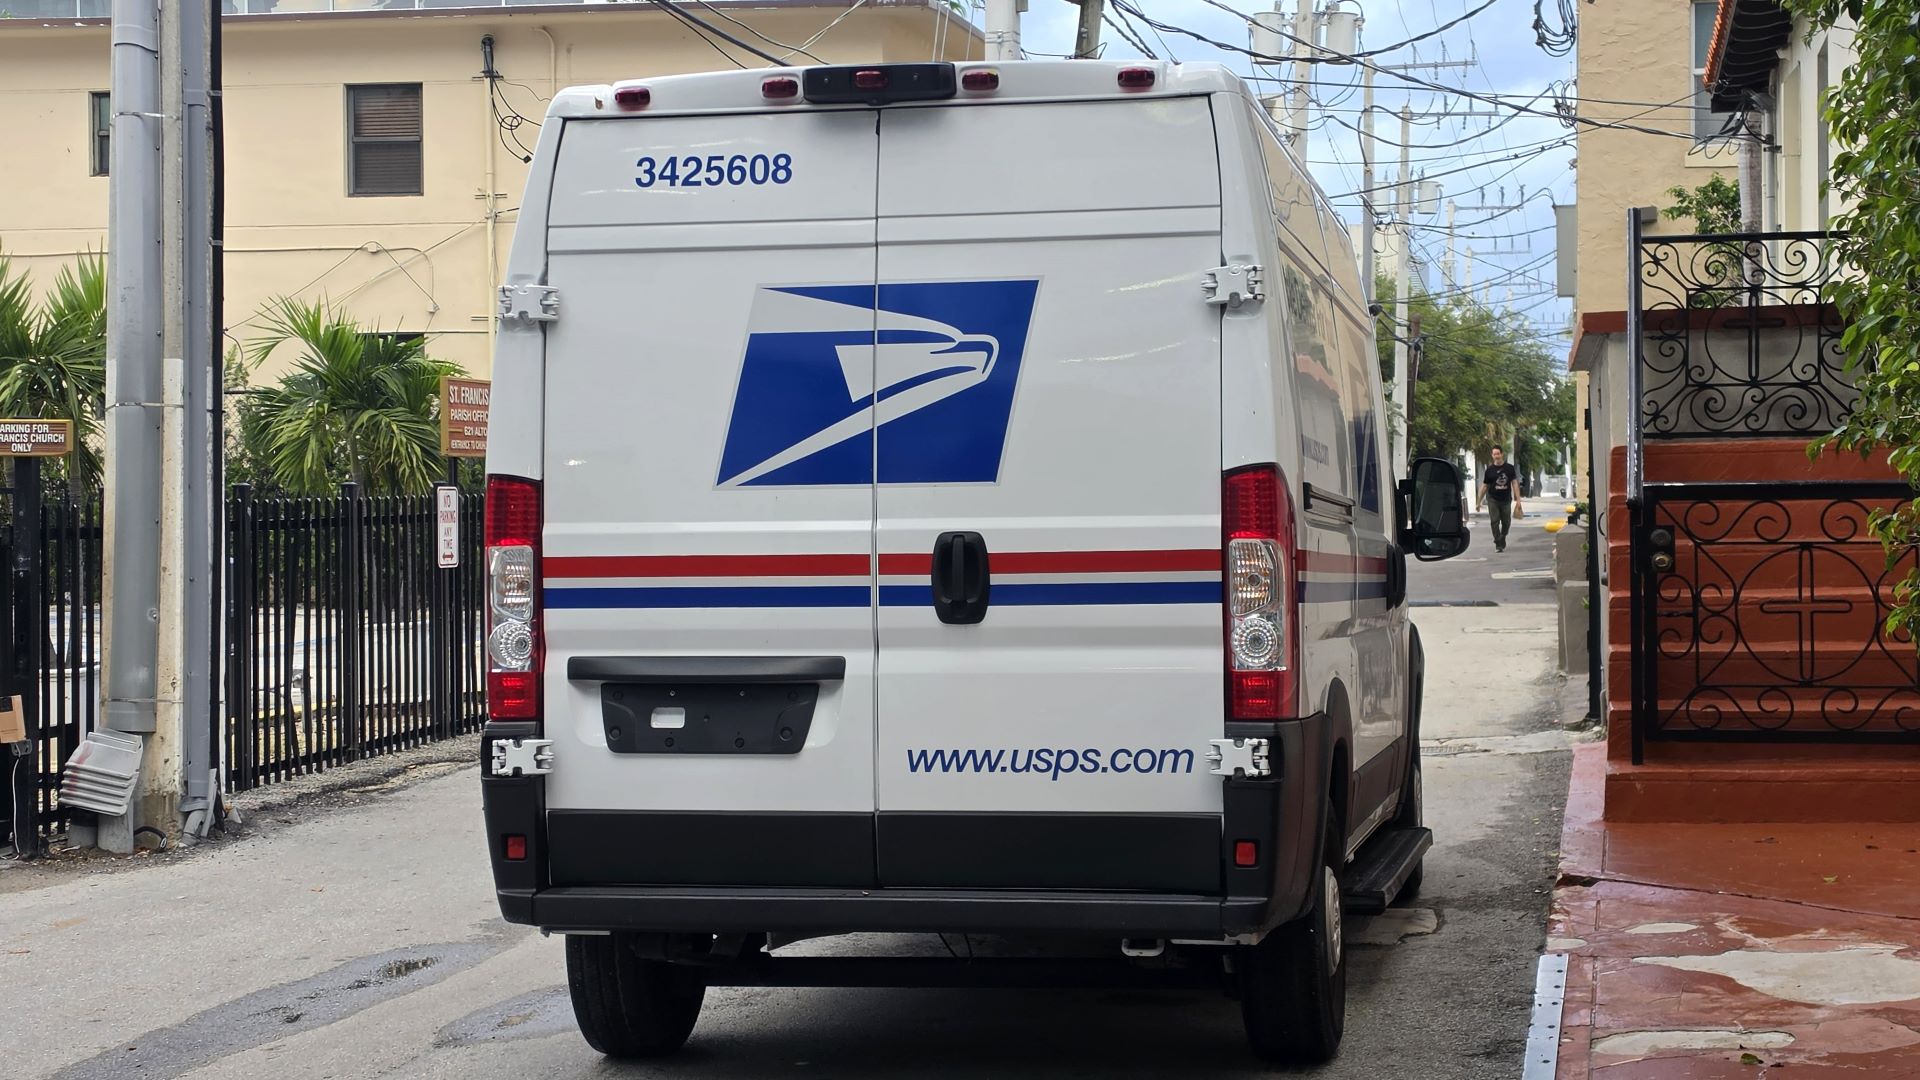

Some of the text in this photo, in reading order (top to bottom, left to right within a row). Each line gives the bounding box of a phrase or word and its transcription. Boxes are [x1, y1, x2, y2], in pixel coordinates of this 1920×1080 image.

[635, 153, 793, 188] 3425608
[449, 385, 489, 406] ST. FRANCIS
[450, 409, 472, 421] PARISH
[0, 424, 49, 433] ARKING FOR
[30, 433, 65, 443] CHURCH
[11, 443, 33, 452] ONLY
[443, 495, 451, 508] NO
[440, 510, 456, 524] PARKING
[443, 527, 452, 538] ANY
[443, 538, 453, 549] TIME
[907, 747, 1195, 781] www.usps.com
